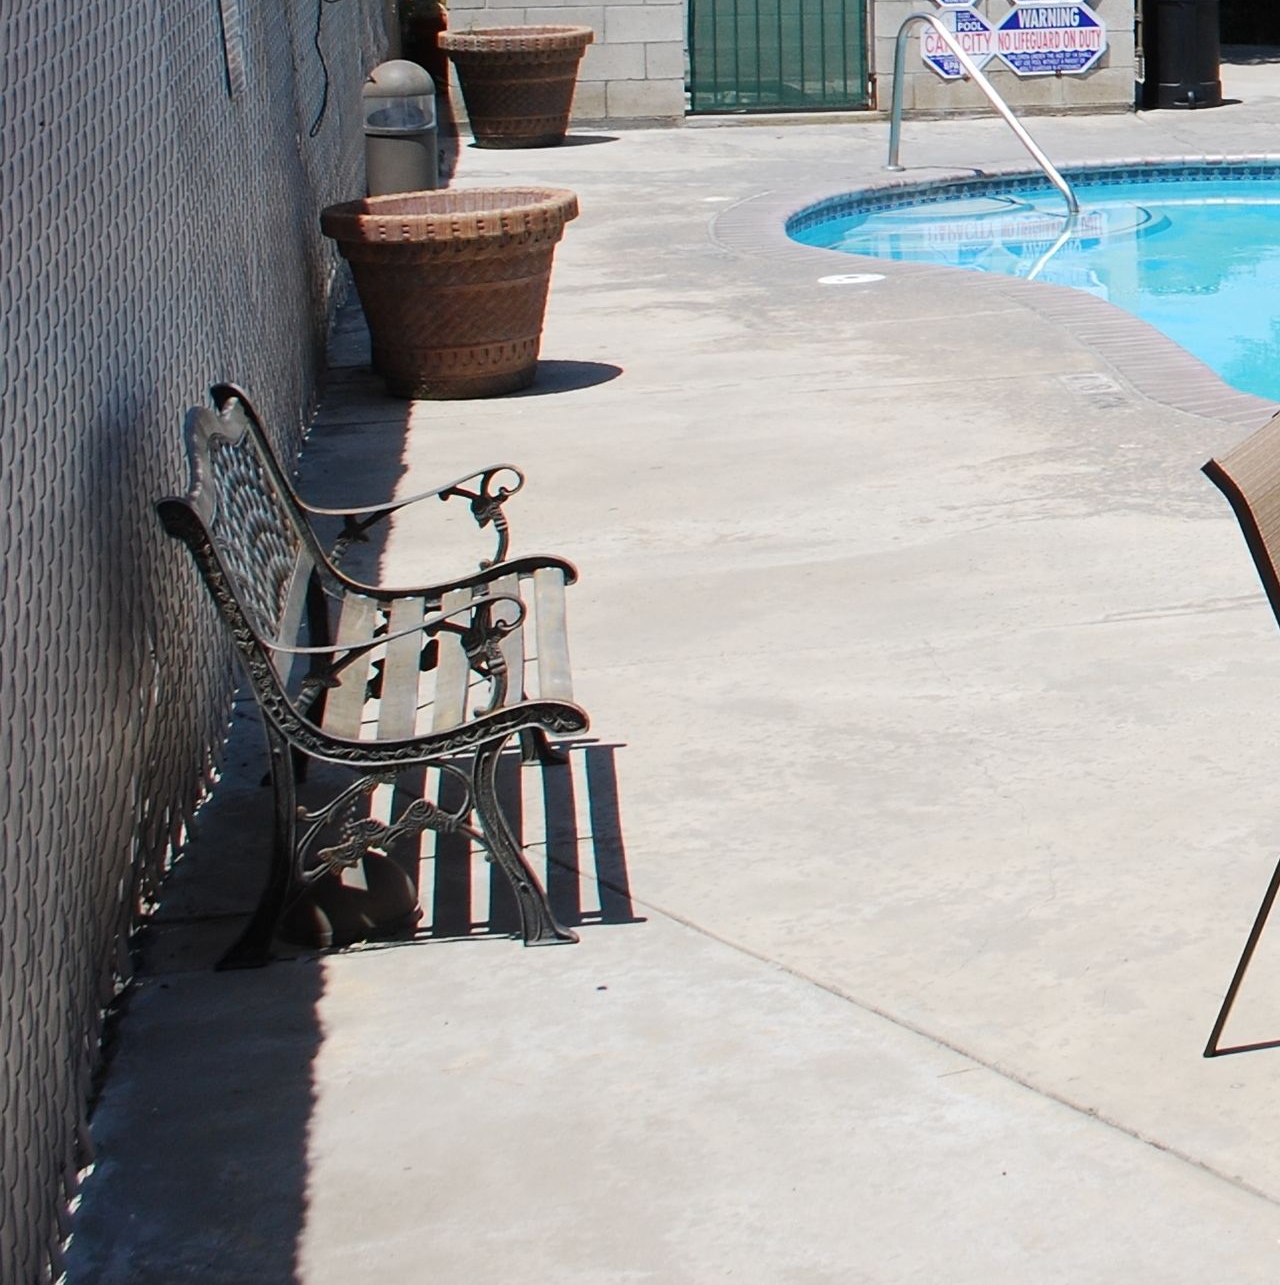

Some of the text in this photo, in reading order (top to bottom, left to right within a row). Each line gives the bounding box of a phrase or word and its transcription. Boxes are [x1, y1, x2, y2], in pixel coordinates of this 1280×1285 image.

[957, 22, 983, 31] POOL
[1018, 7, 1080, 28] WARNING
[925, 32, 992, 53] CACITY
[999, 29, 1101, 50] NO LIFEGUARD ON DUTY
